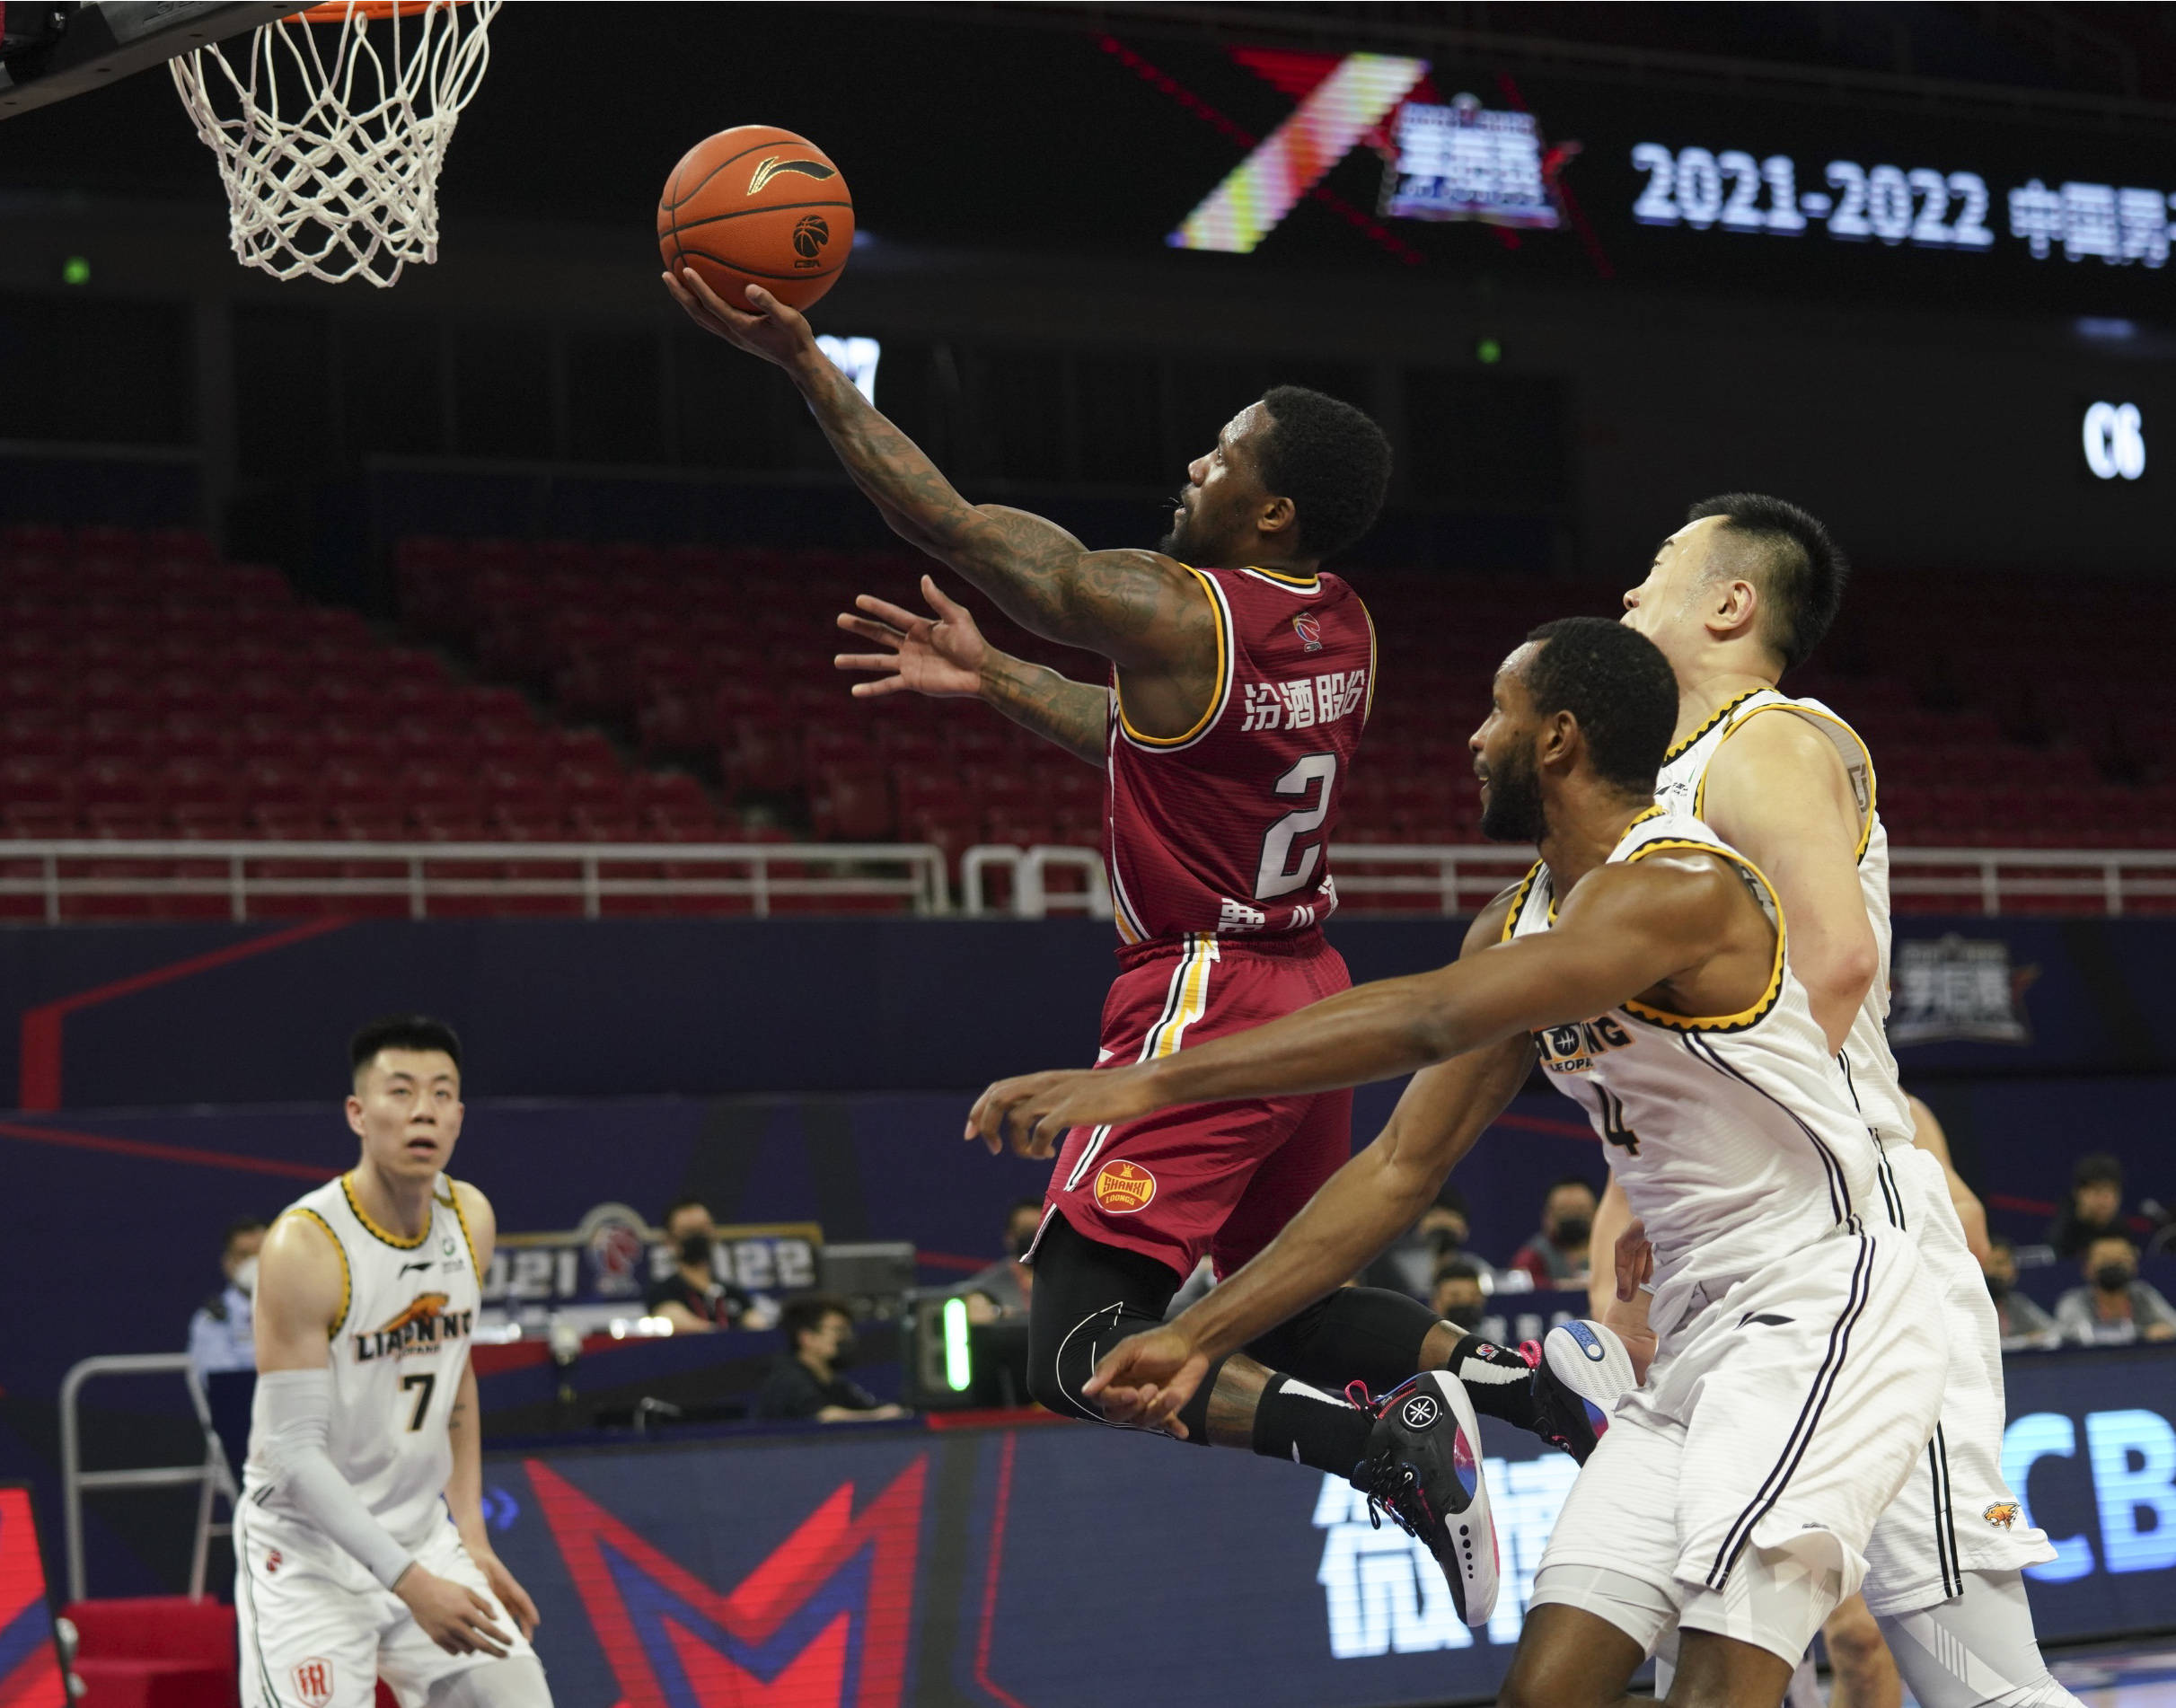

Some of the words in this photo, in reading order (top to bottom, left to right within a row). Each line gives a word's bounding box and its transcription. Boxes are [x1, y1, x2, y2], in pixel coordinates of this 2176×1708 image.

[1631, 142, 1995, 251] 2021-2022
[2007, 178, 2176, 269] 中国男
[1240, 669, 1366, 732] 汾酒股份
[1255, 751, 1337, 901] 2
[1103, 1175, 1147, 1197] SHANXI
[1106, 1194, 1135, 1206] LOONGS
[482, 1249, 579, 1302] 021
[401, 1373, 436, 1432] 7
